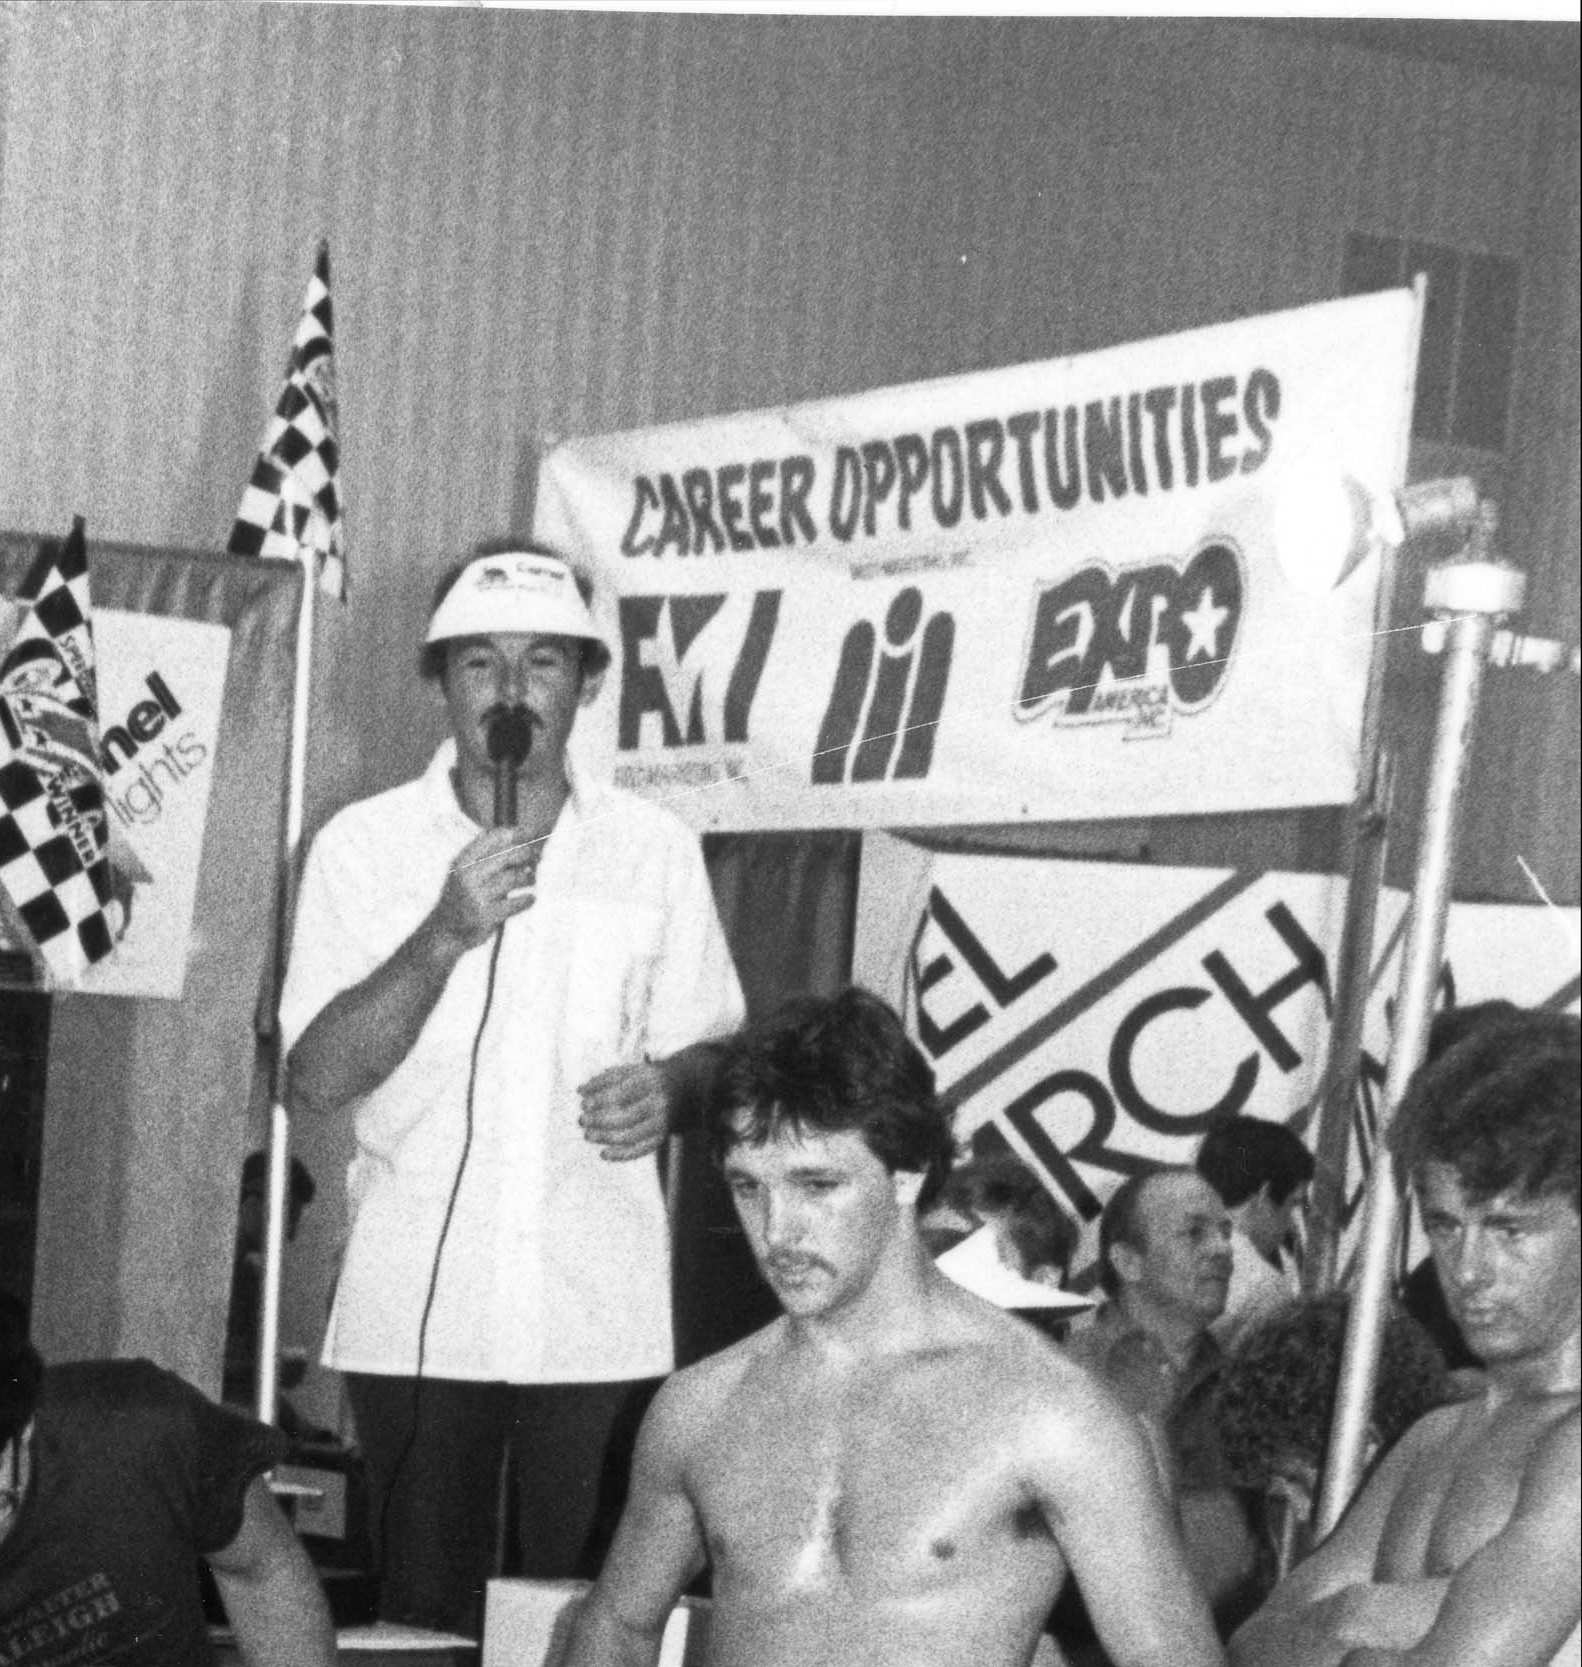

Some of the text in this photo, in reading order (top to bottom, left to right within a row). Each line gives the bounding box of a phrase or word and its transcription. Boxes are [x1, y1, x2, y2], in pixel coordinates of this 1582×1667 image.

[621, 367, 1281, 558] CAREER OPPORTUNITIES
[1019, 544, 1242, 712] EXPO
[975, 900, 1332, 1222] RCH
